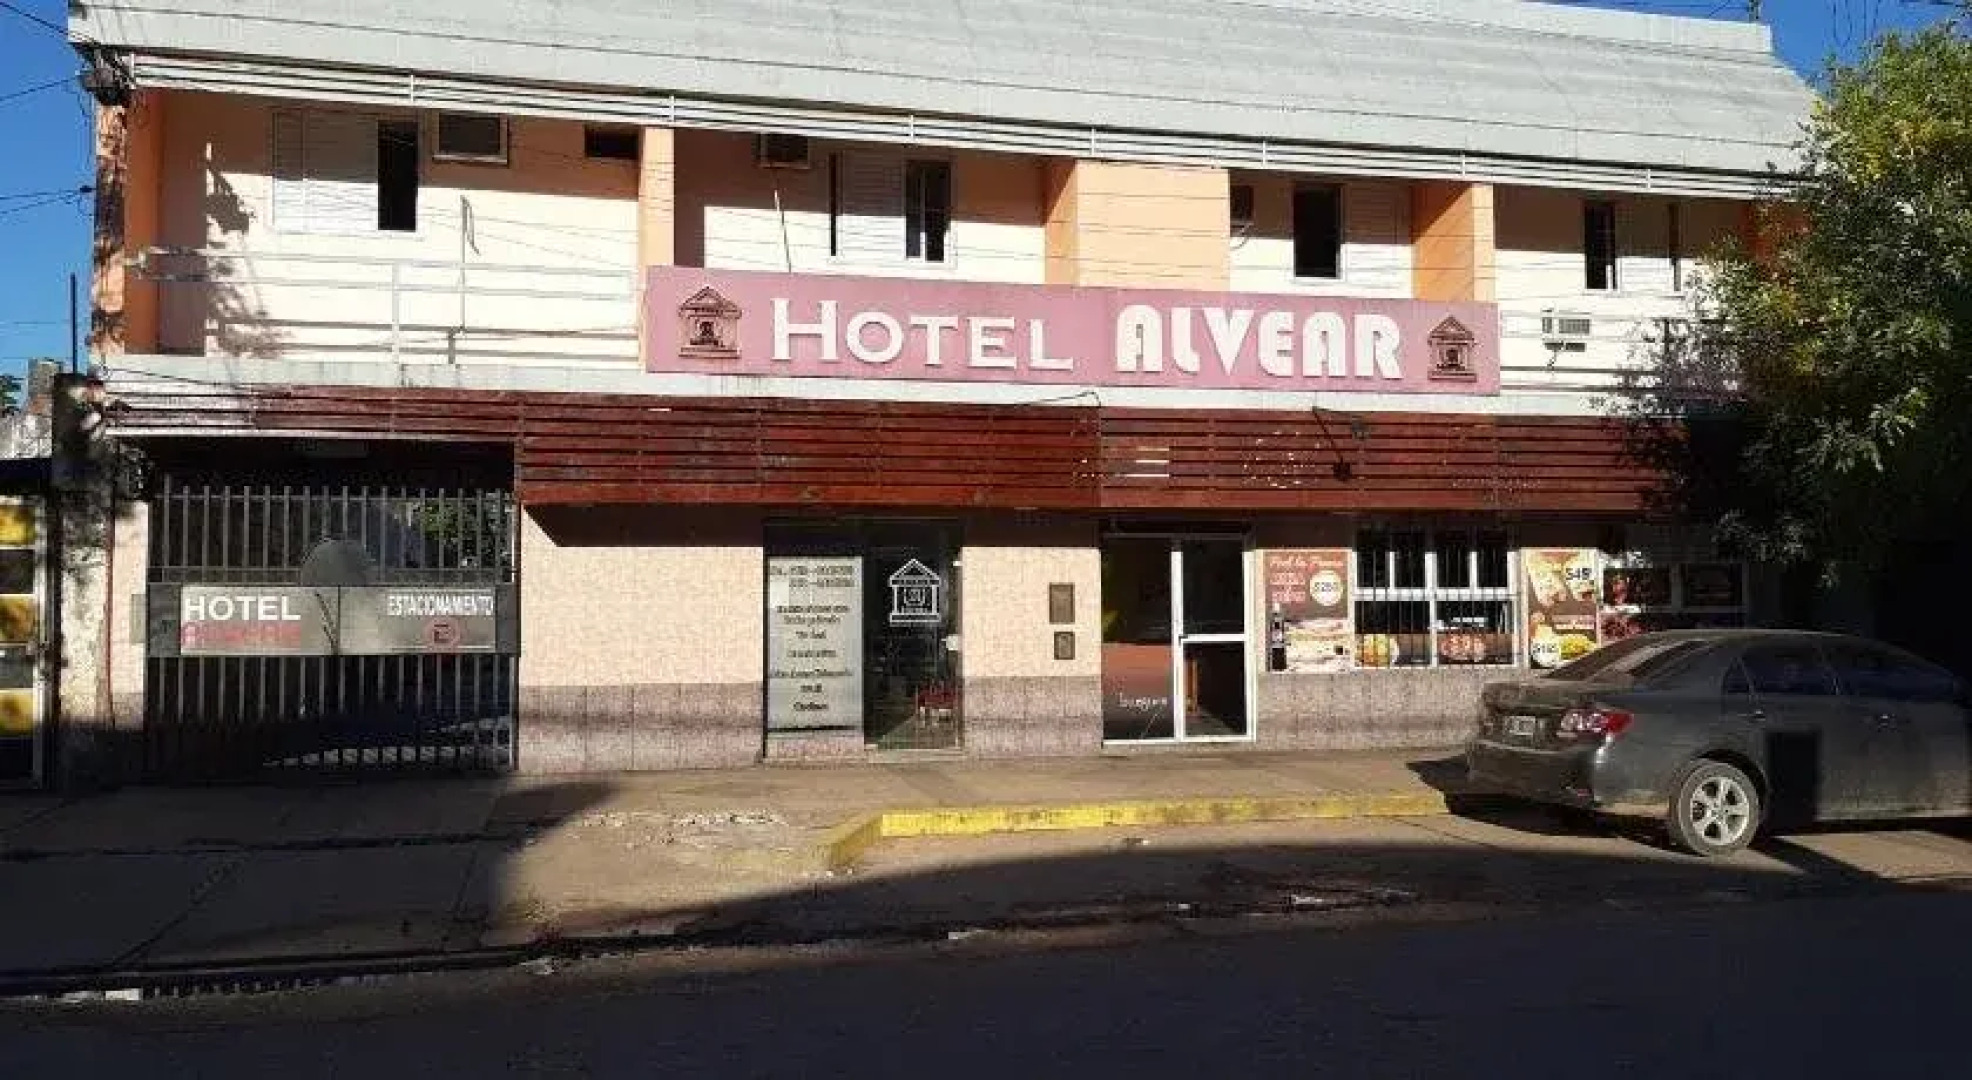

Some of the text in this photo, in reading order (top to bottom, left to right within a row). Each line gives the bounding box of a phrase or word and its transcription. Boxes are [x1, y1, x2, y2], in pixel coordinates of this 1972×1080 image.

[770, 298, 1404, 379] HOTEL ALVEAR
[184, 595, 302, 620] HOTEL
